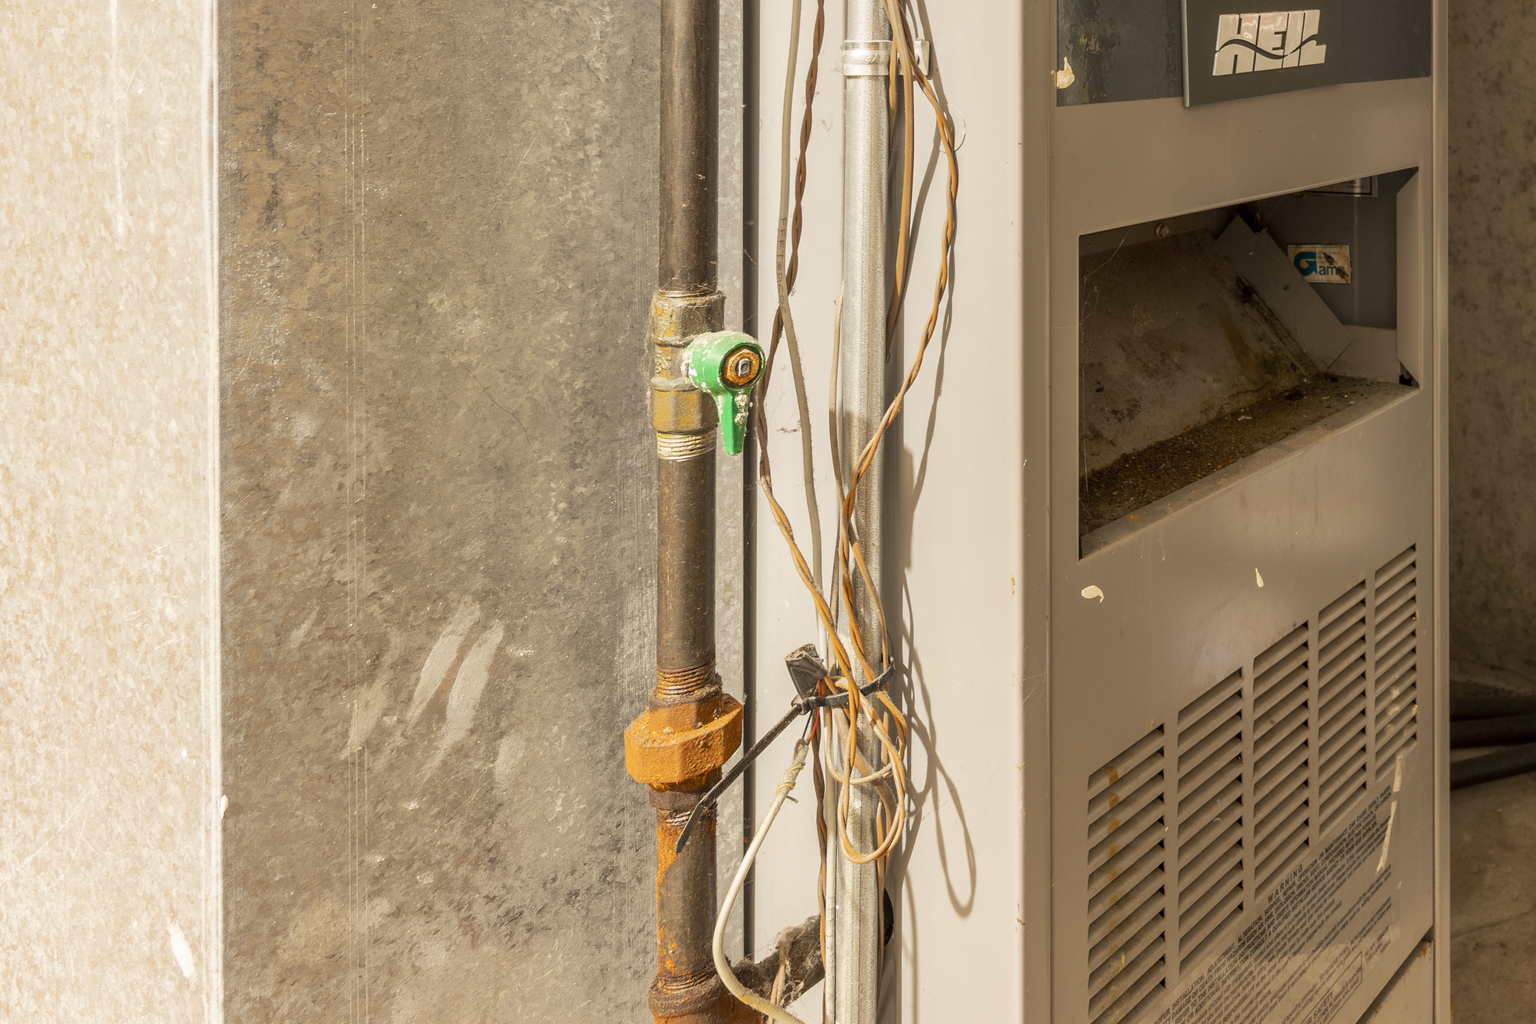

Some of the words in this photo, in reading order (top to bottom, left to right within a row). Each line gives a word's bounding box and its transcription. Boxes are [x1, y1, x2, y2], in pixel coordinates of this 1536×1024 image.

[1212, 10, 1327, 76] HEIL
[1267, 864, 1304, 904] WARNING
[1313, 990, 1334, 1020] SAFETY
